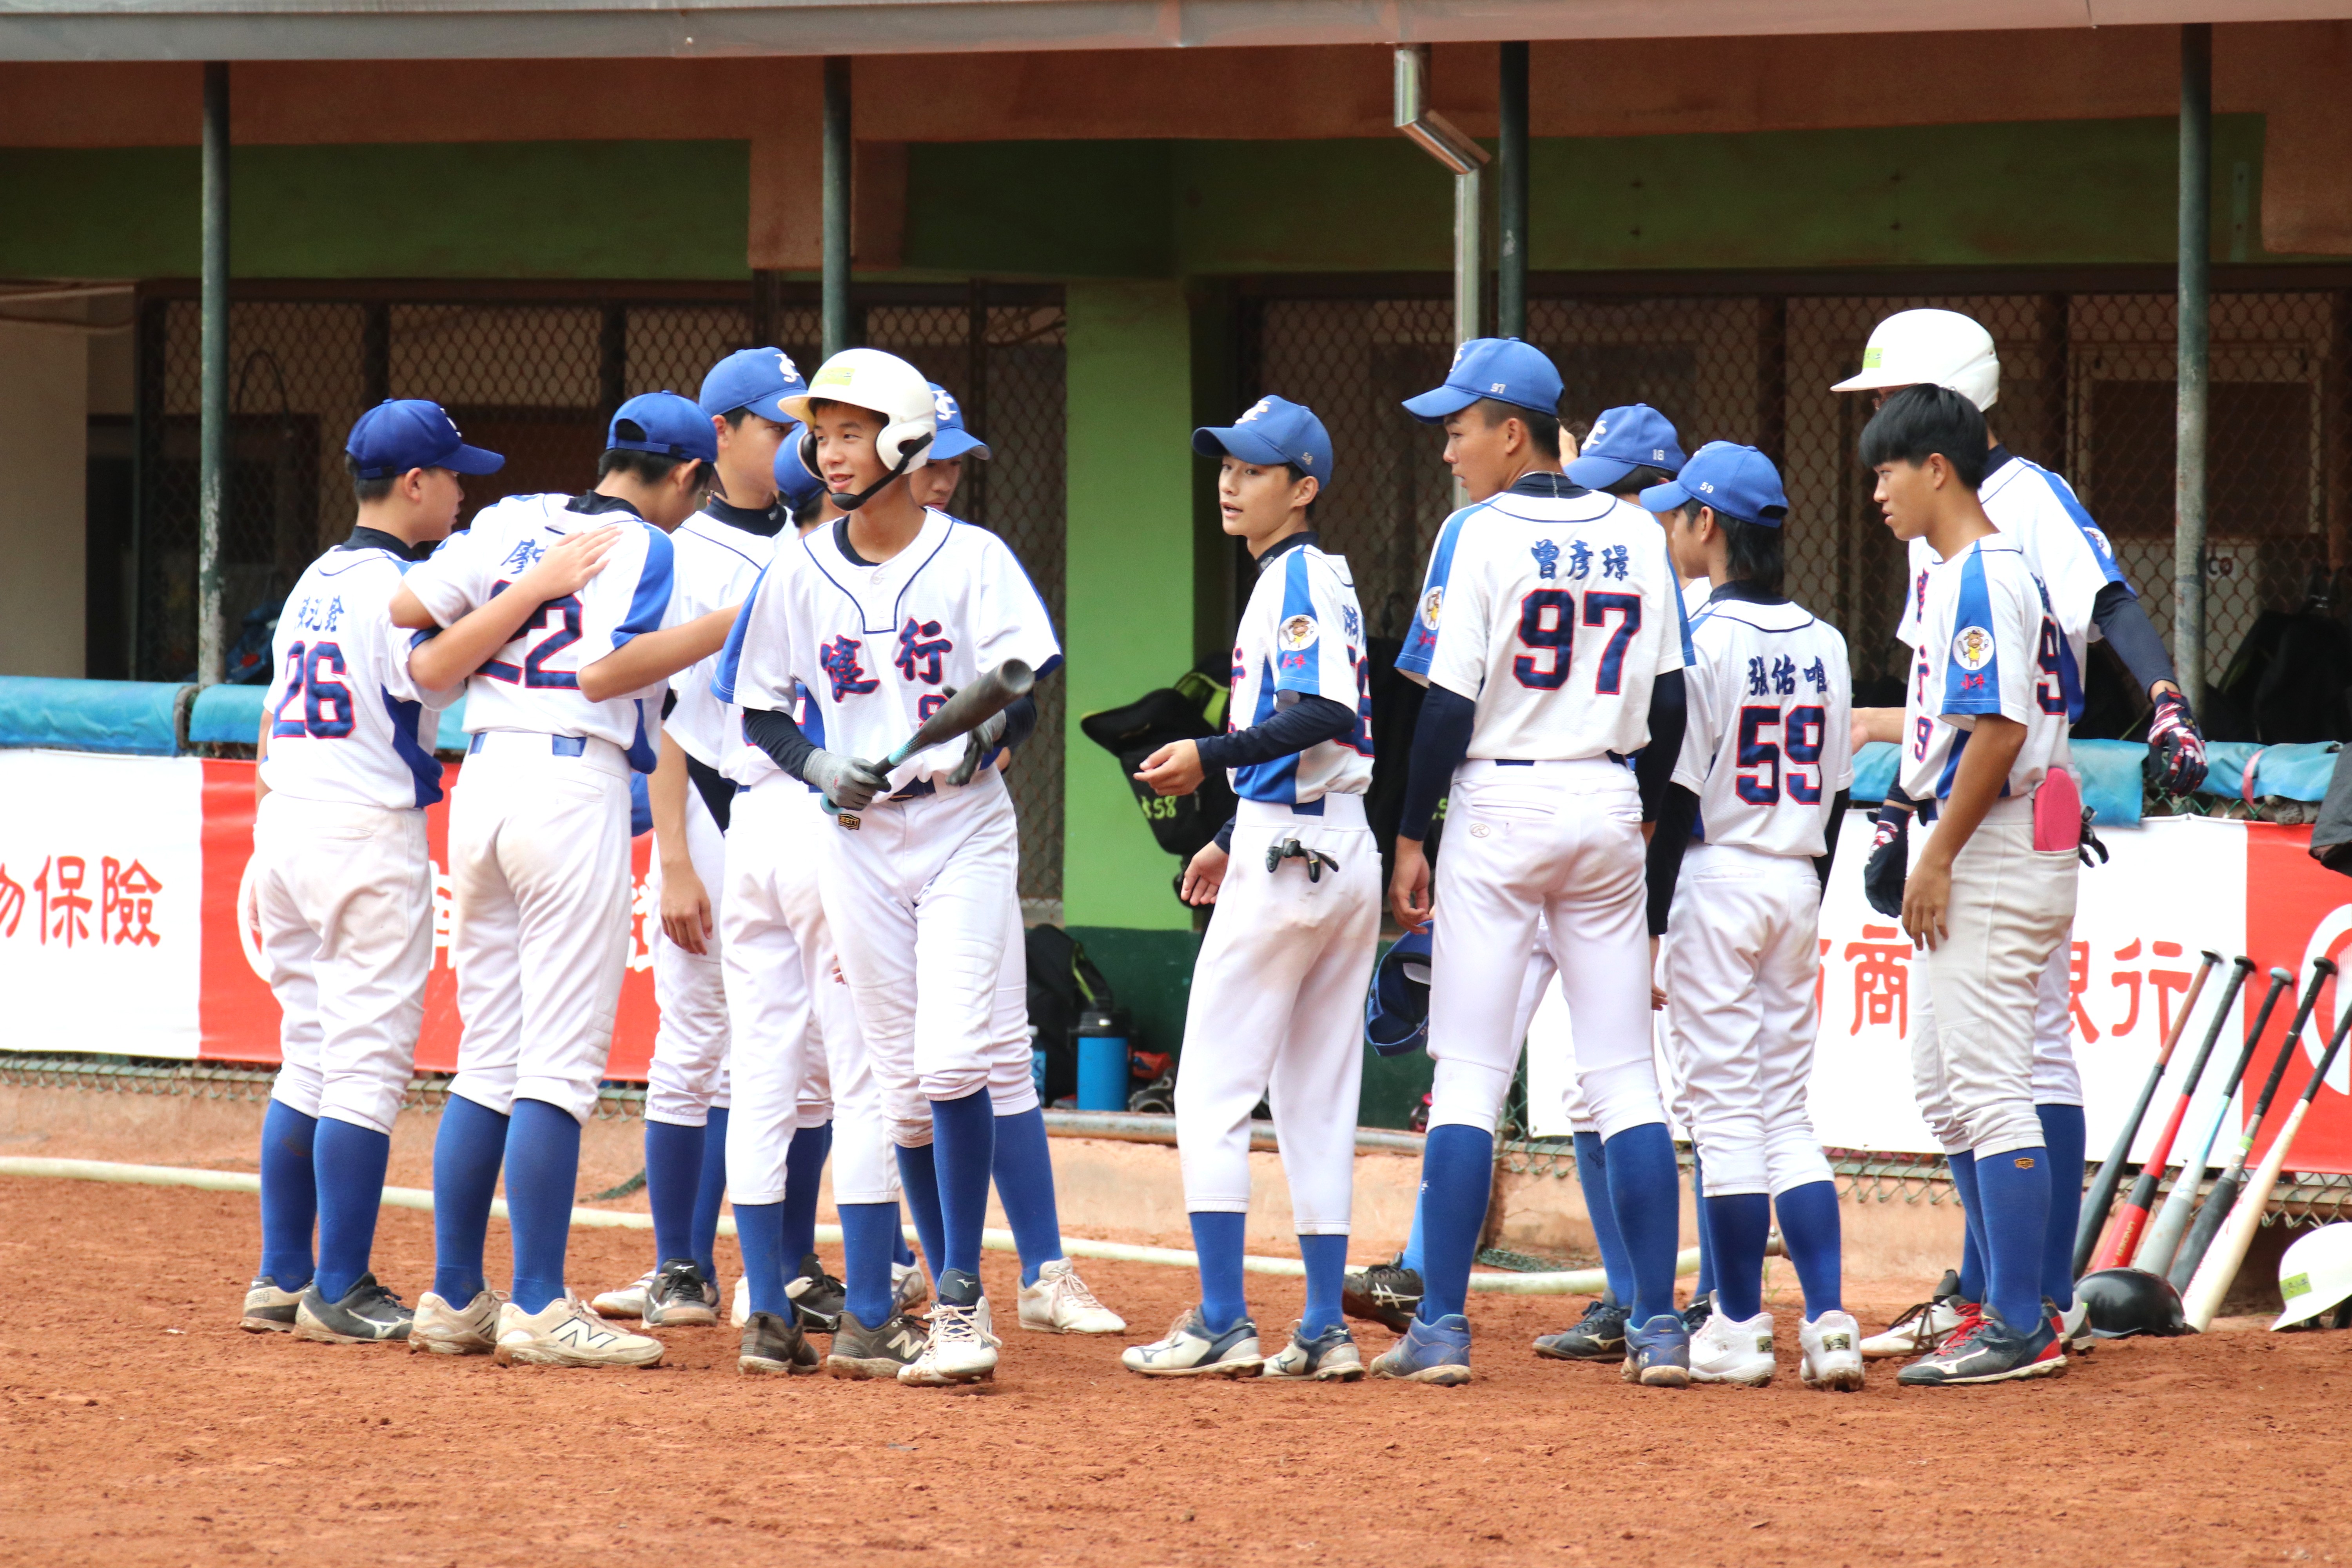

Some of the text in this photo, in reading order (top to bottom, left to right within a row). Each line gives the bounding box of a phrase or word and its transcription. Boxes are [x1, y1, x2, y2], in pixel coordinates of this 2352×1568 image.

[1490, 383, 1506, 394] 97
[1700, 482, 1714, 494] 59
[273, 640, 356, 739] 26
[1513, 588, 1642, 695] 97
[1735, 705, 1826, 806] 59
